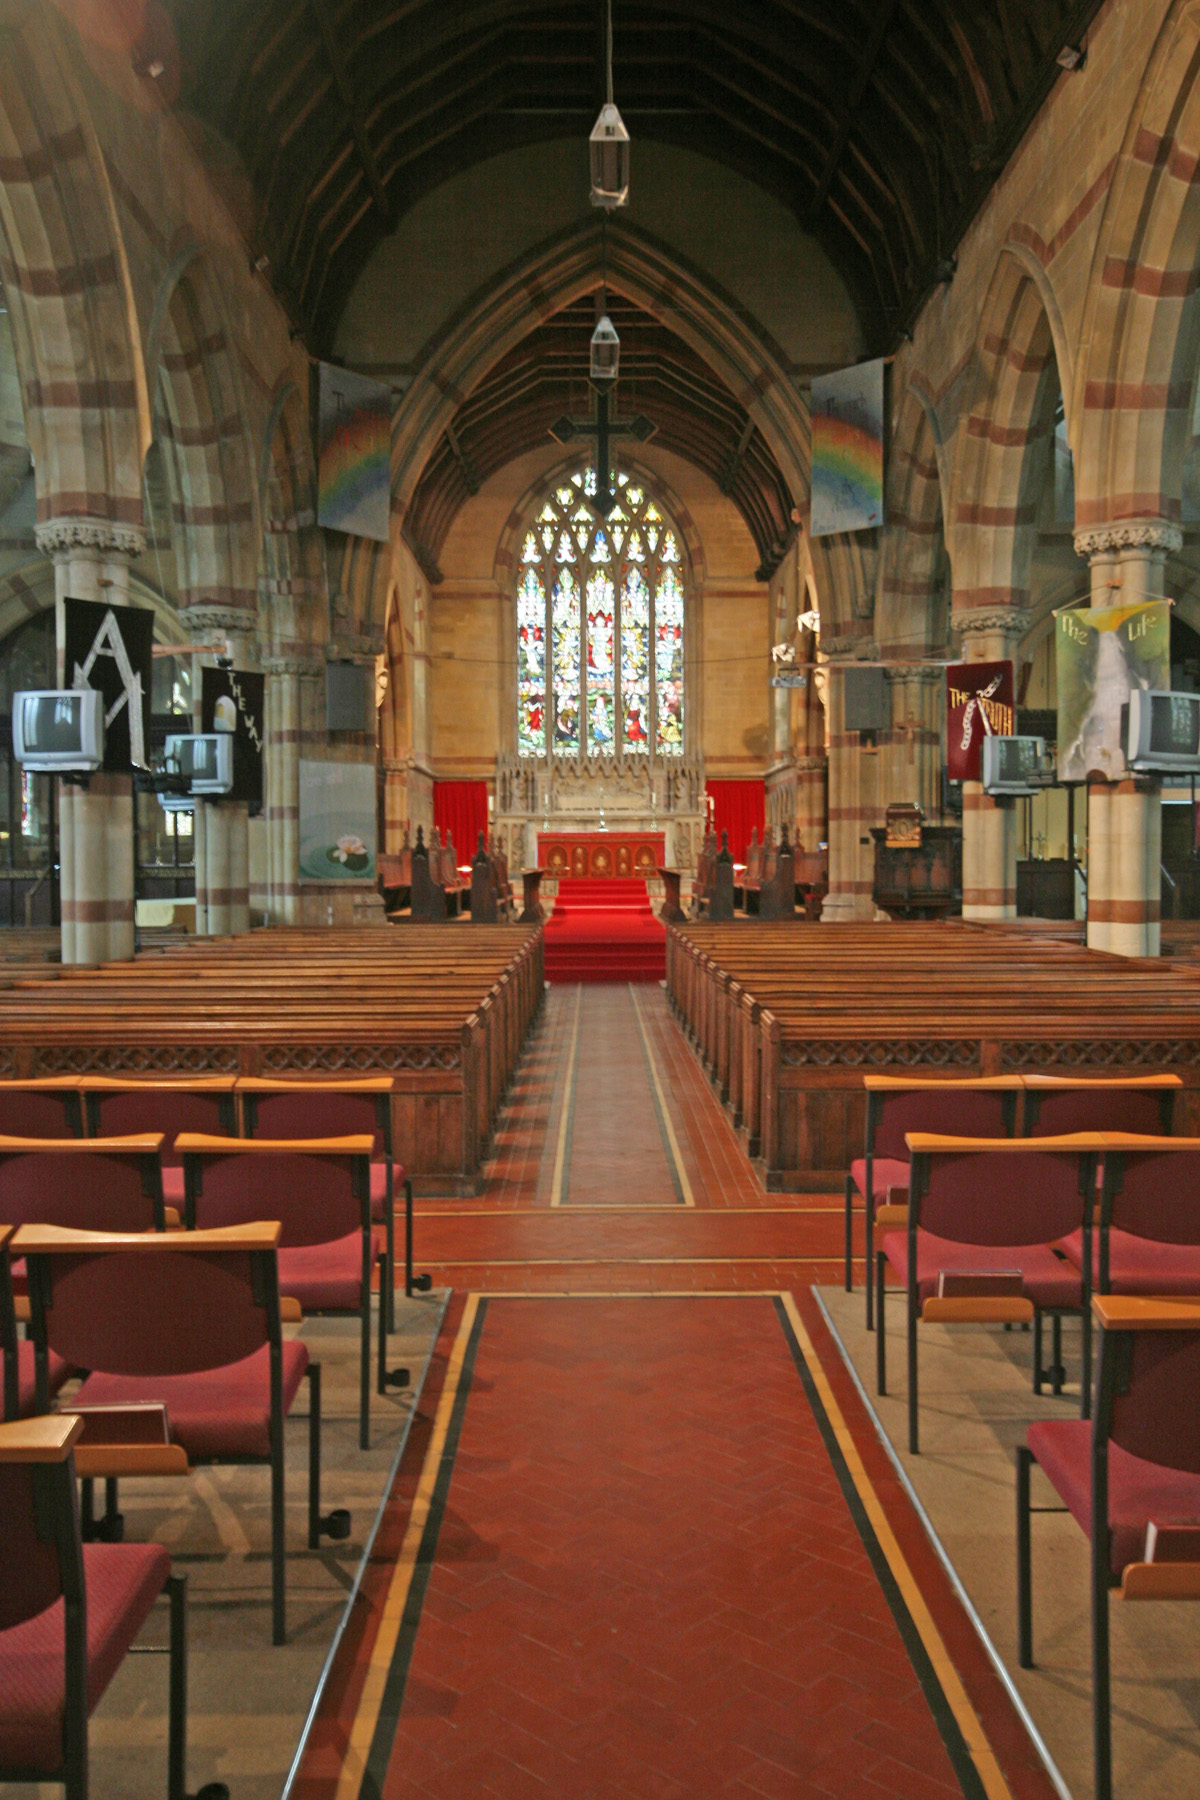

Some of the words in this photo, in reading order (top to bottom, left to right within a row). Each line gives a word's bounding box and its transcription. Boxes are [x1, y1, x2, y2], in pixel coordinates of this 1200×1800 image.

[227, 672, 247, 711] THE
[244, 714, 264, 753] WAY
[949, 687, 971, 709] THE
